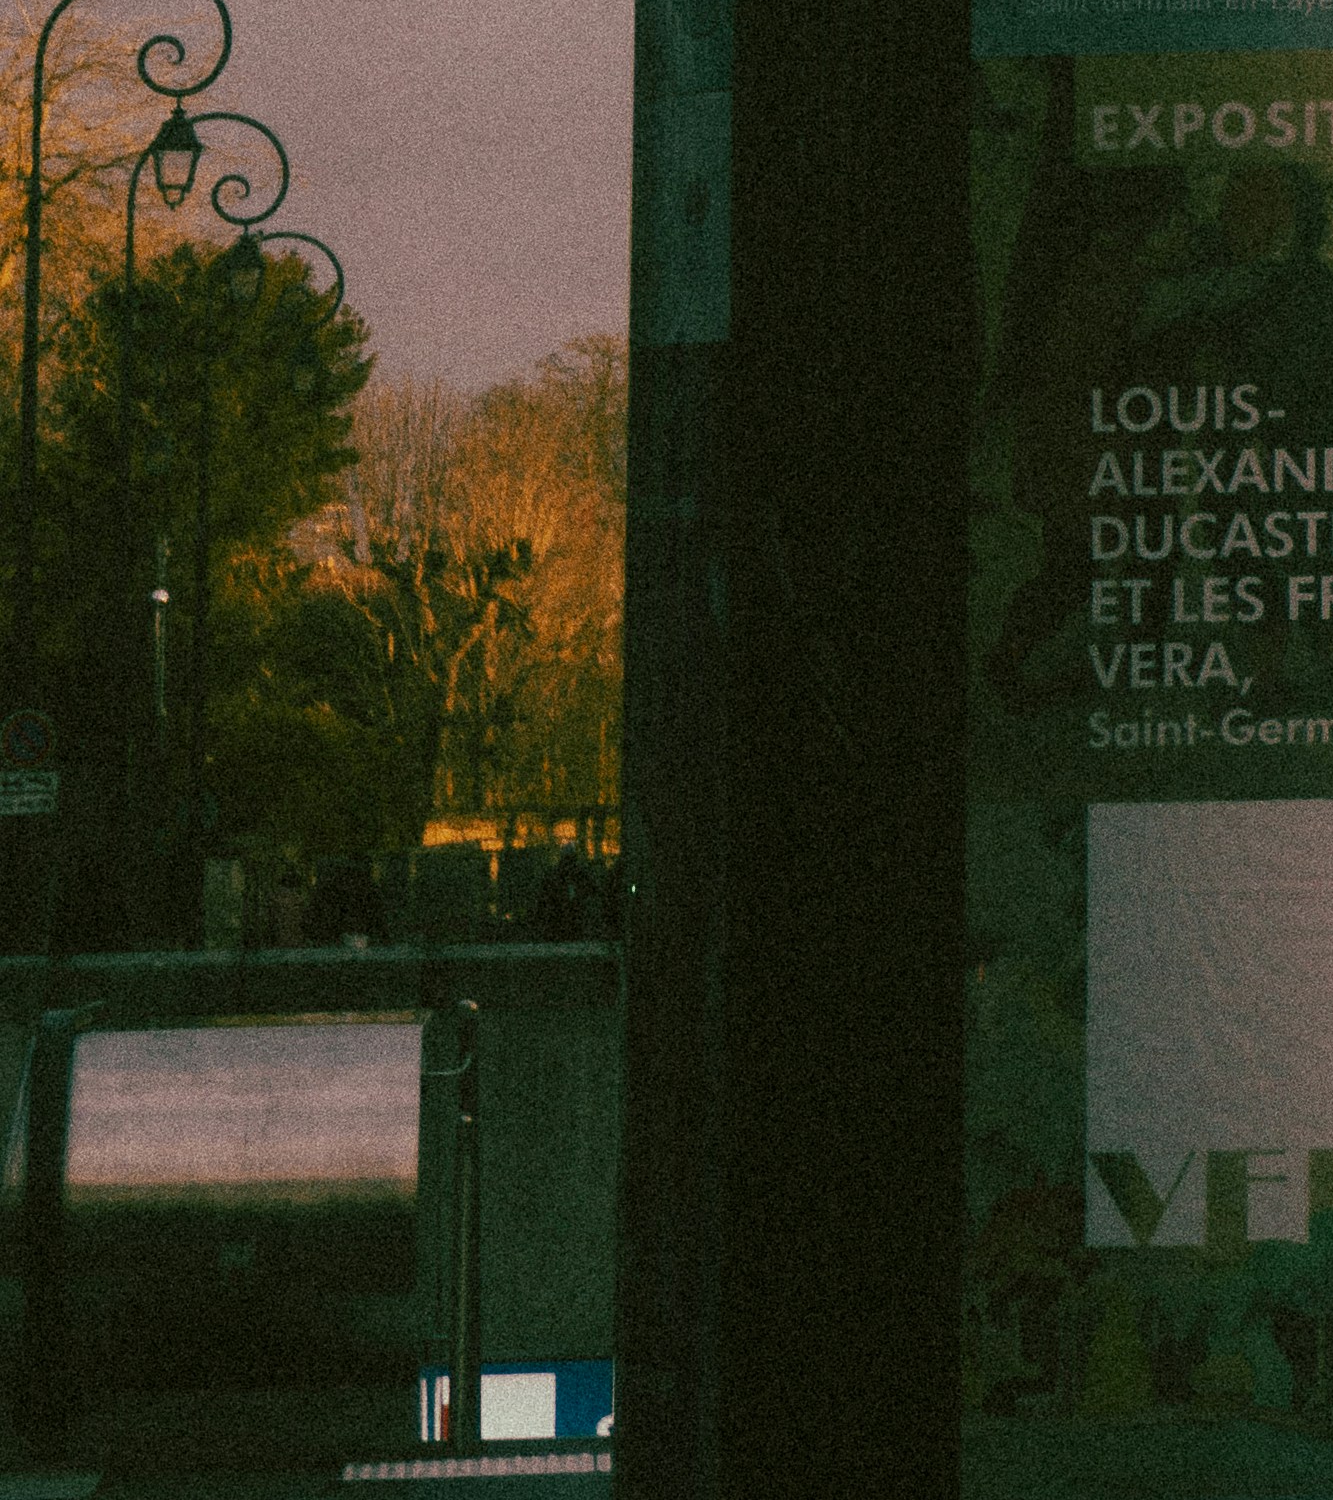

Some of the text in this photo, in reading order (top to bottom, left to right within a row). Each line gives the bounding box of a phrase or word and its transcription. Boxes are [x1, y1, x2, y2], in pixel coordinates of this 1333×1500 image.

[1092, 386, 1285, 435] LOUIS-
[1092, 577, 1148, 624] ET
[1173, 575, 1263, 623] LES
[1091, 641, 1255, 695] VERA,
